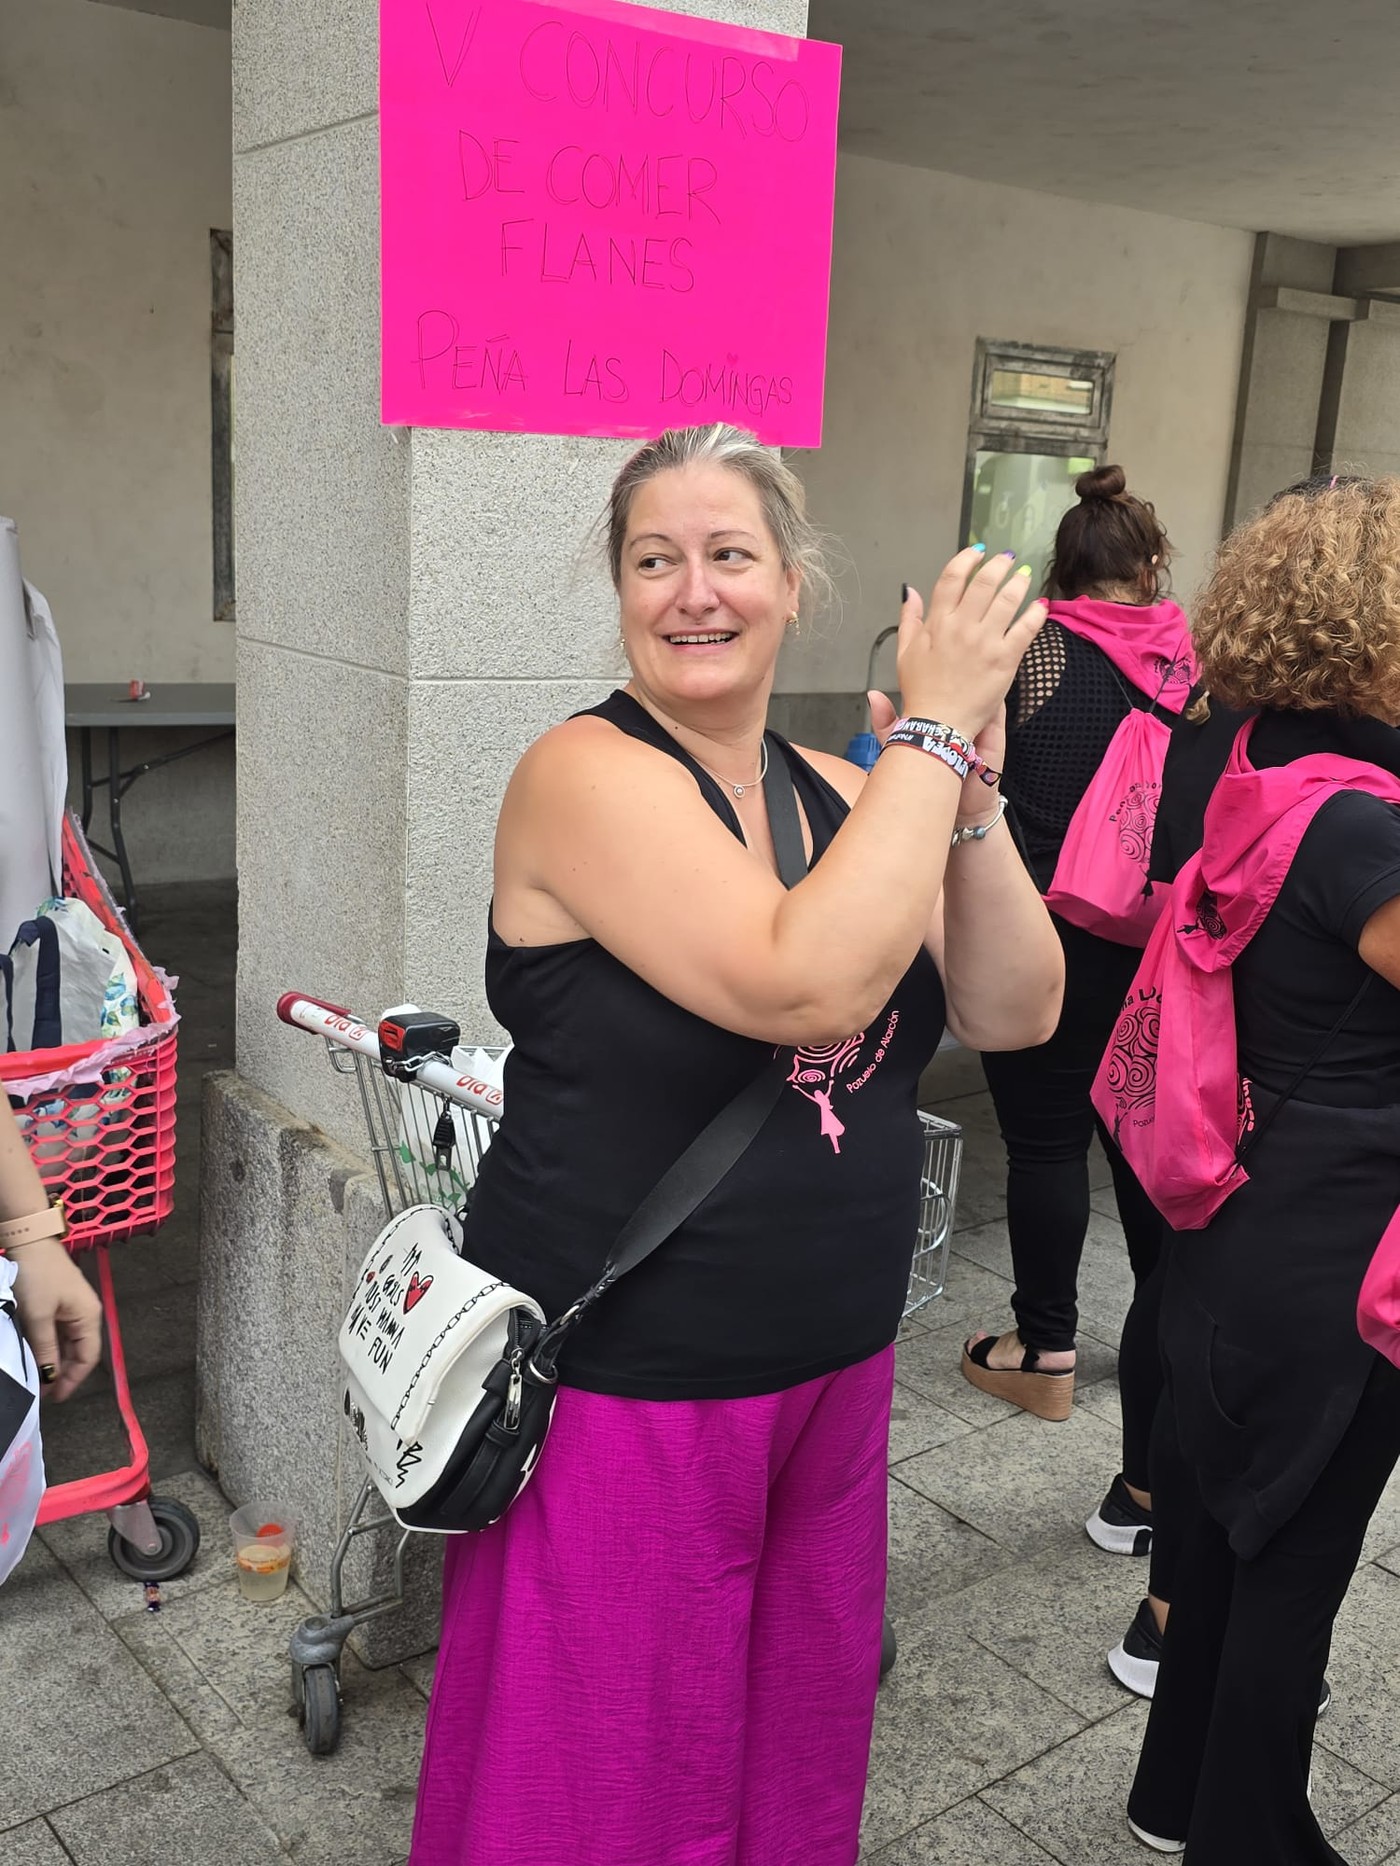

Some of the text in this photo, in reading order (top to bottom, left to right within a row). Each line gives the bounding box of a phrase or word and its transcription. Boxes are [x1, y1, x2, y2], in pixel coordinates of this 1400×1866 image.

[426, 2, 809, 142] V CONCURSO
[459, 130, 721, 224] DE COMER
[500, 218, 694, 292] FLANES
[411, 310, 792, 416] PEÑA LAS DOMINGAS
[846, 1010, 899, 1093] Pozuelo de Alarcón
[368, 1336, 393, 1375] FUN
